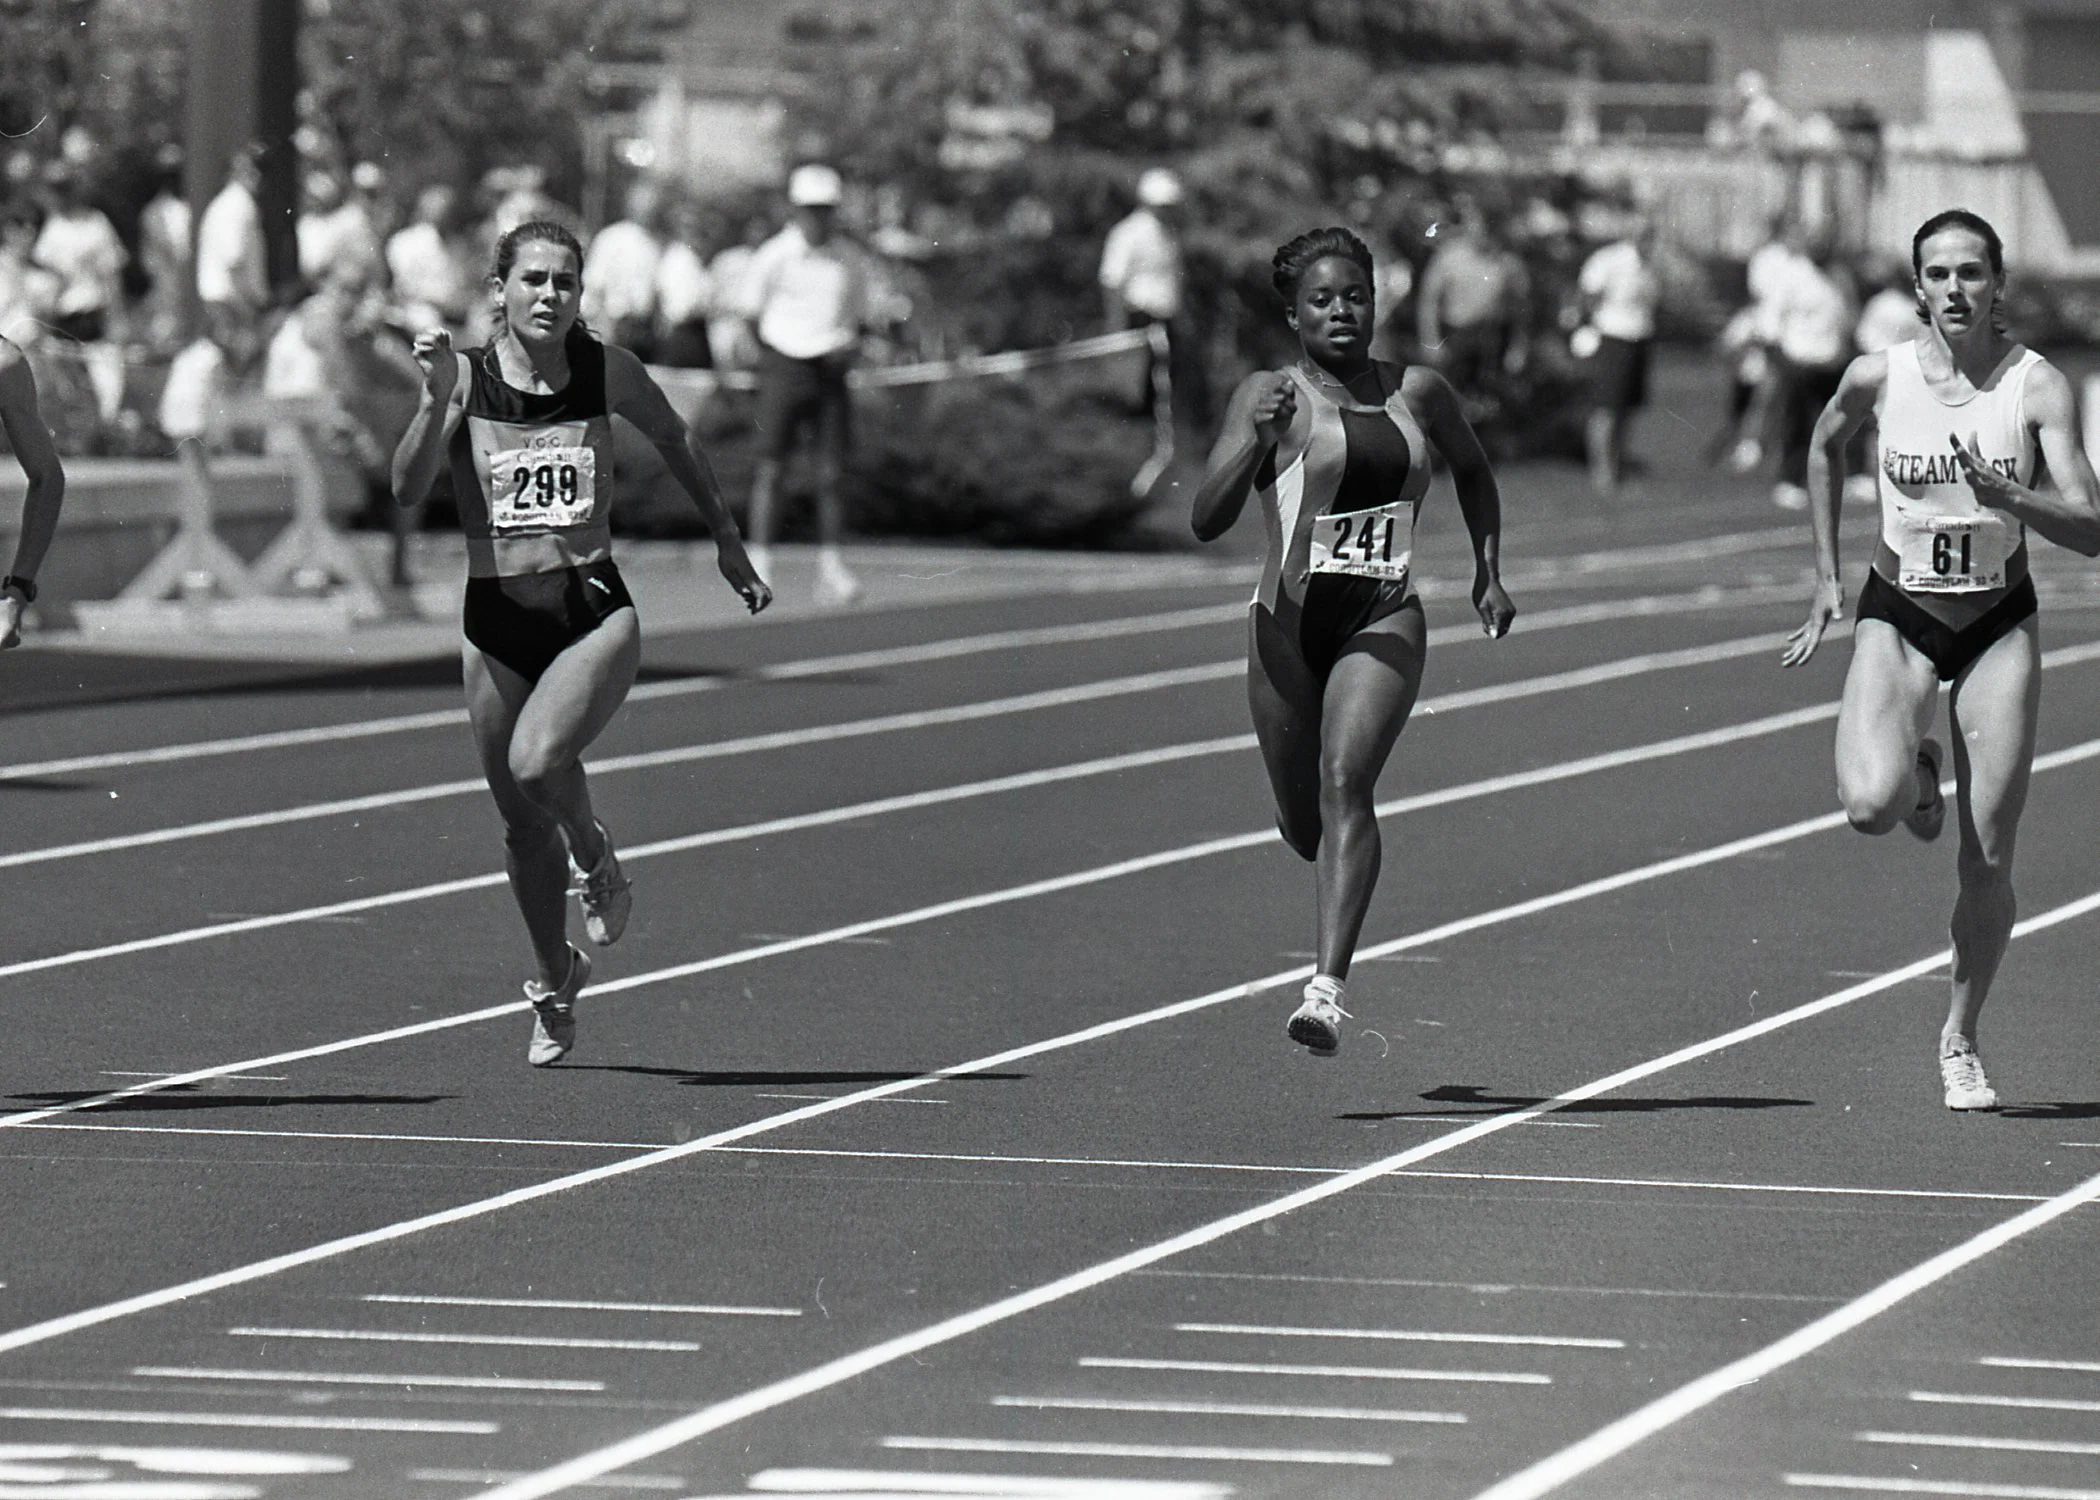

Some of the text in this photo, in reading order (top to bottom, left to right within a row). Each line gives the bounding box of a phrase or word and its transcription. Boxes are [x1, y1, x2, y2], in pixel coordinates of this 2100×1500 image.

[513, 464, 578, 510] 299
[1897, 454, 1958, 485] TEAM
[1332, 516, 1395, 562] 241
[1932, 533, 1971, 576] 61
